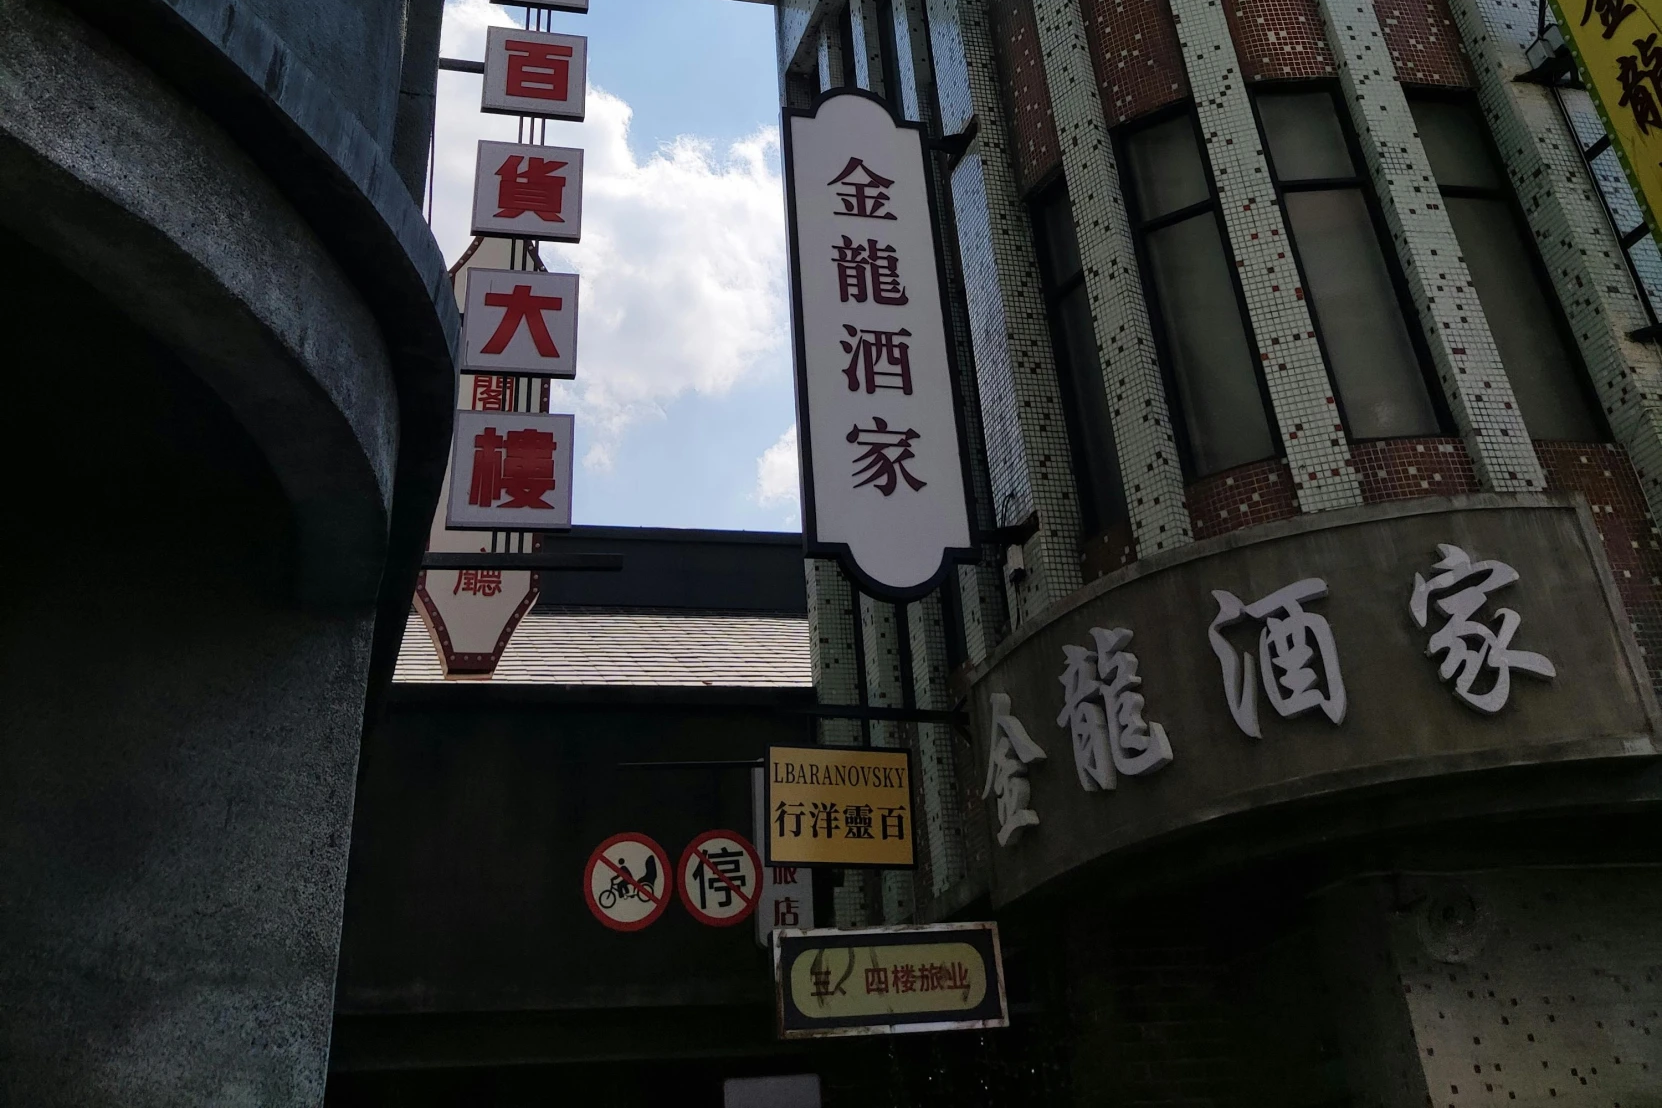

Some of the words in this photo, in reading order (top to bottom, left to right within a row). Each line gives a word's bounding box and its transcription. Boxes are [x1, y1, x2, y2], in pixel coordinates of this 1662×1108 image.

[827, 157, 927, 497] 金龍酒家
[982, 543, 1556, 847] 金龍酒家
[692, 847, 746, 909] 停
